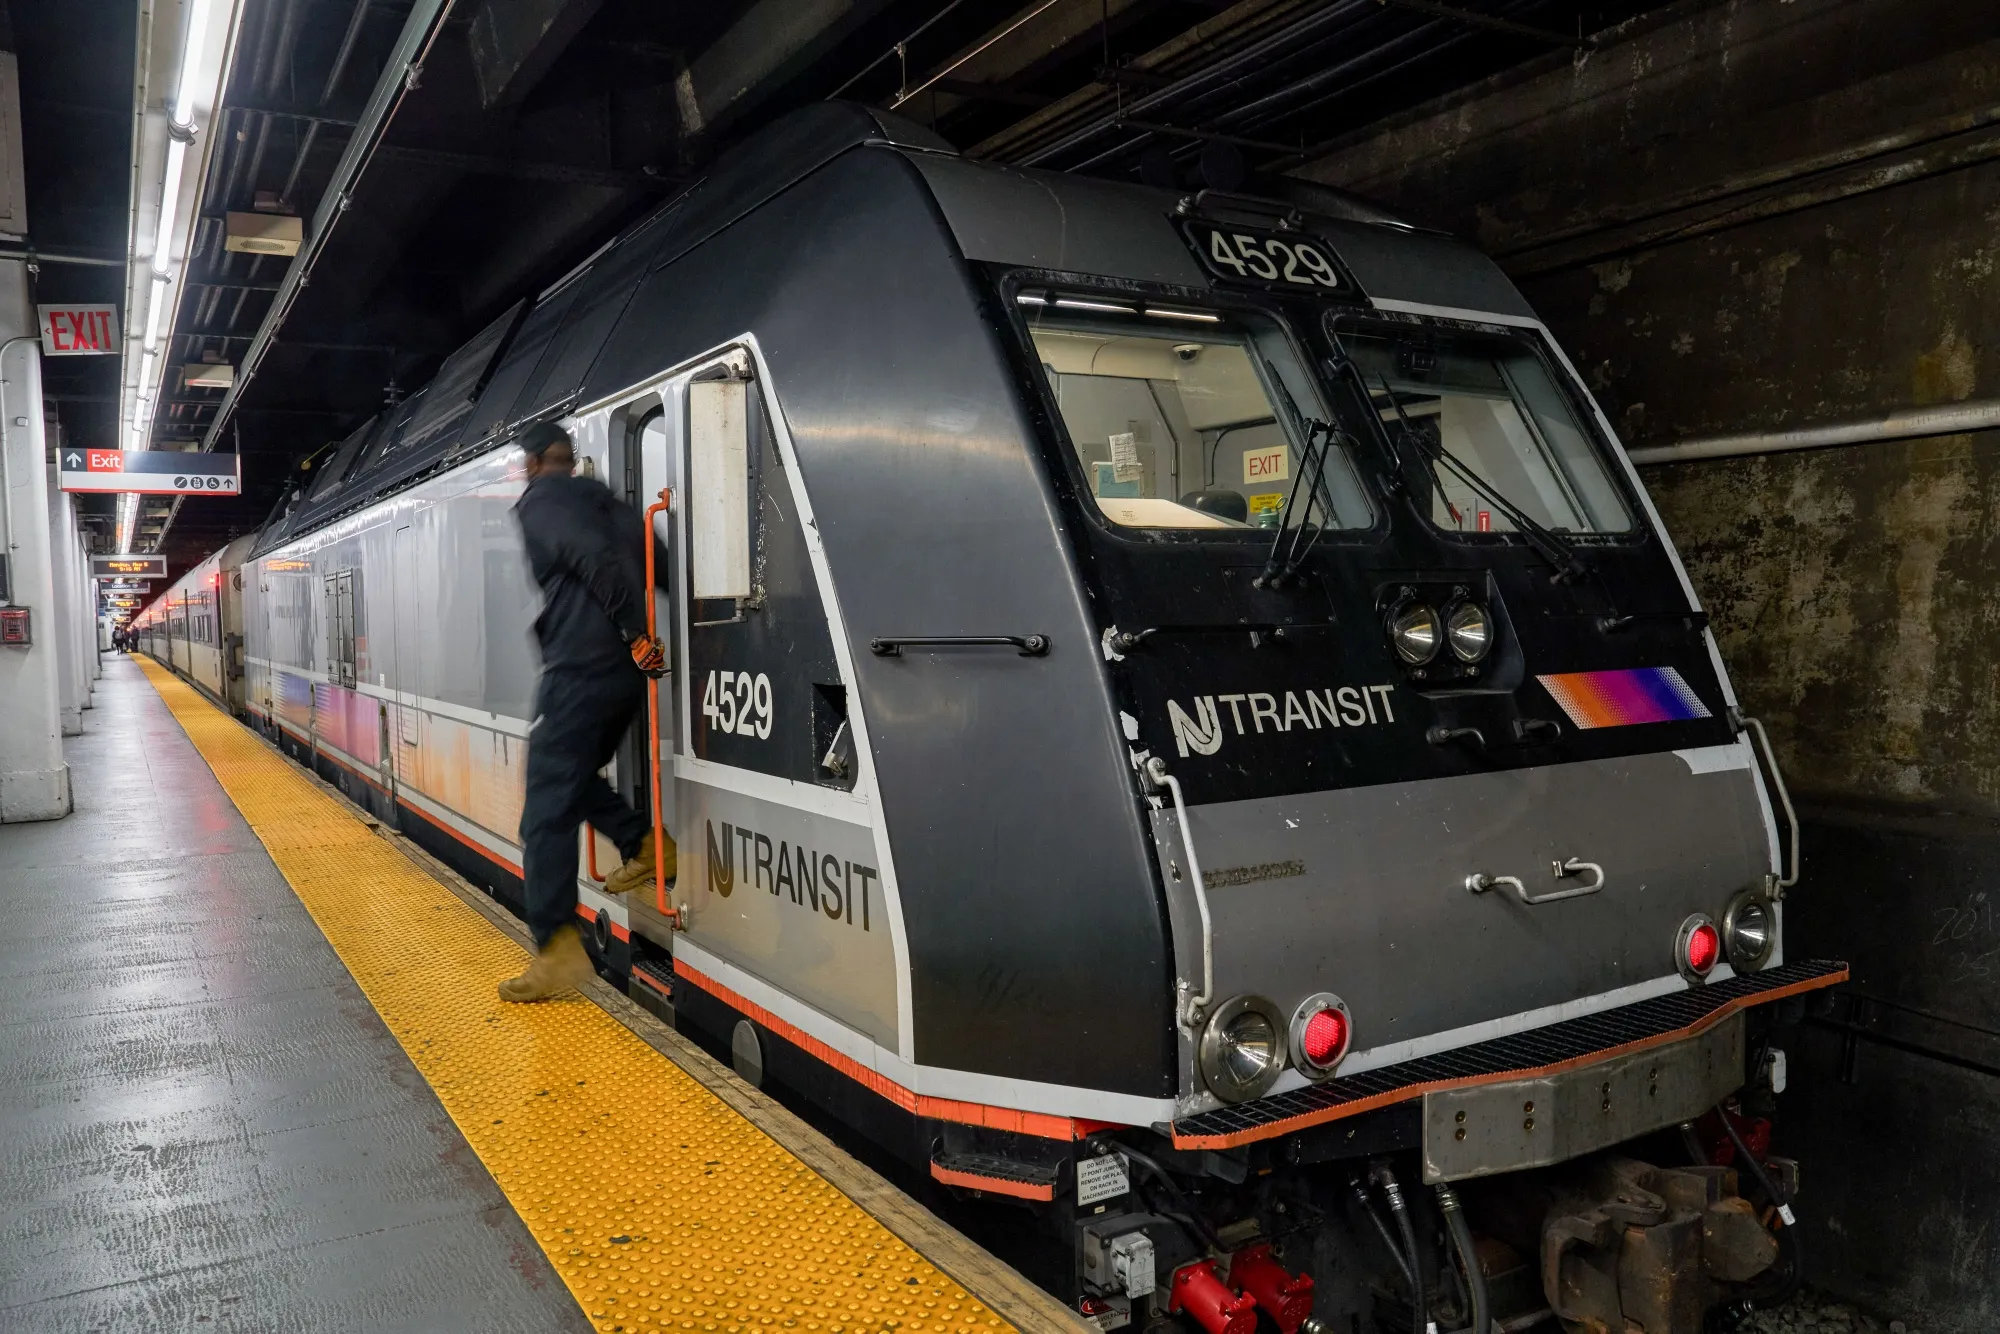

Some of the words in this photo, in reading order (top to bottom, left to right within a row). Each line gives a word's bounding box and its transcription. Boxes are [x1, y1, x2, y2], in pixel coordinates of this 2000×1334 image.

[1211, 230, 1338, 287] 4529
[49, 311, 112, 350] EXIT
[91, 454, 121, 468] Exit
[1249, 454, 1281, 477] EXIT
[702, 669, 773, 740] 4529
[1218, 684, 1395, 735] TRANSIT
[735, 826, 877, 932] TRANSIT
[1087, 1168, 1102, 1177] POINT
[1095, 1158, 1105, 1167] NOT
[1080, 1176, 1102, 1187] REMOVE
[1110, 1169, 1126, 1178] PLACE
[1098, 1181, 1111, 1189] RACK
[1082, 1189, 1110, 1201] MACHINERY
[1111, 1184, 1126, 1193] ROOM
